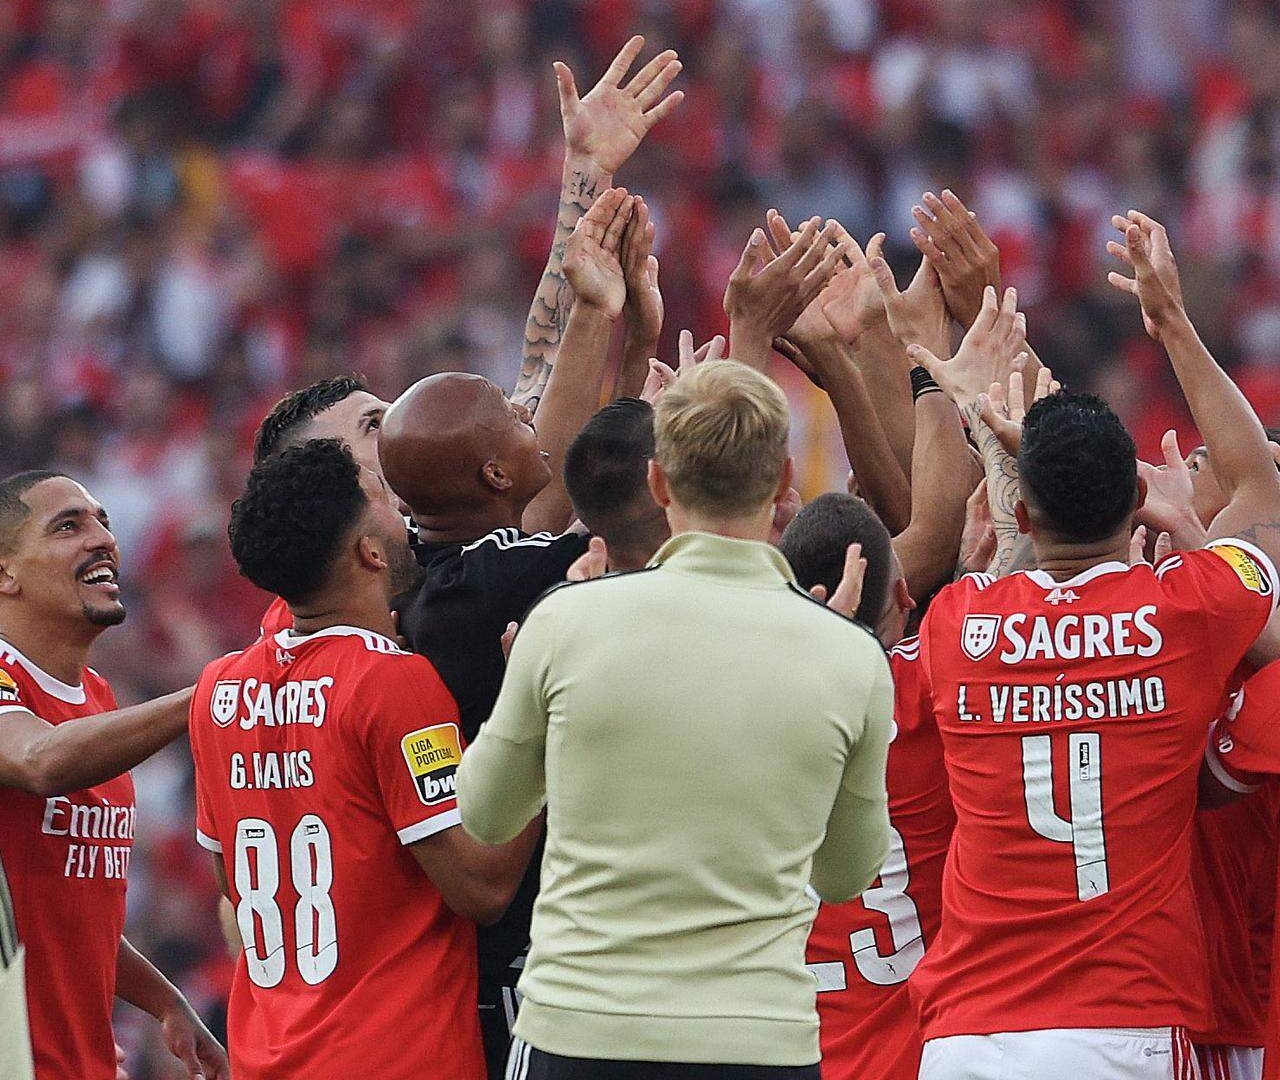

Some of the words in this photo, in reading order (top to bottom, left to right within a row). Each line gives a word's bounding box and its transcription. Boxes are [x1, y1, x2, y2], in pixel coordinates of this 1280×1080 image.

[1000, 605, 1163, 665] SAGRES
[958, 685, 981, 721] L.
[990, 673, 1166, 723] VERÍSSIMO
[410, 738, 433, 755] LIGA
[423, 774, 457, 800] bw
[41, 796, 136, 839] Emirat
[1021, 732, 1109, 903] 4
[64, 844, 99, 878] FLY
[235, 814, 338, 988] 88
